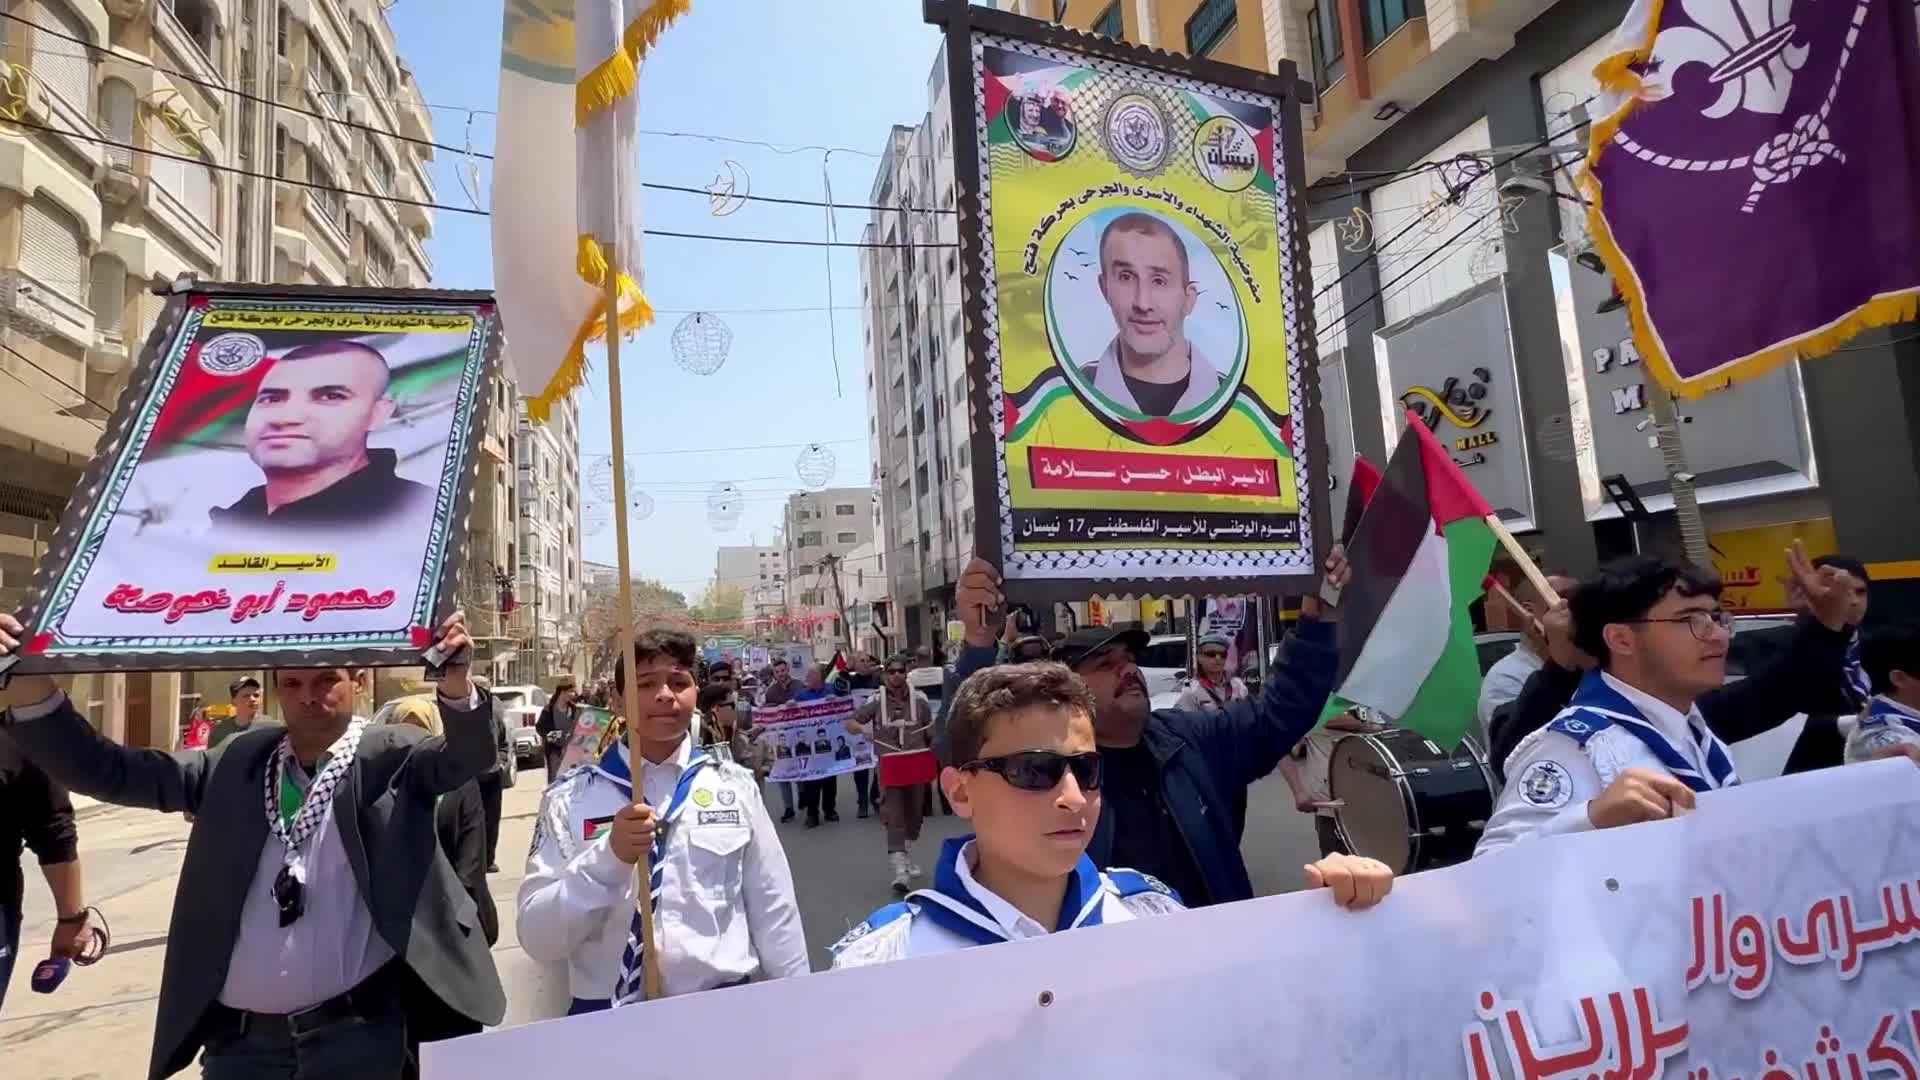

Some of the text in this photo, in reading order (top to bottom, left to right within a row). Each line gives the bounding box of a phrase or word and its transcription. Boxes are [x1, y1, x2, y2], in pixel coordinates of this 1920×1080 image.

[1206, 147, 1255, 170] نيسان
[1023, 182, 1261, 303] مفوضية الشهداء والأسرى والجرحى بحركة فتح
[1456, 432, 1497, 451] MALL
[1040, 457, 1115, 478] سلامة
[1120, 464, 1171, 484] حسن
[1022, 515, 1297, 540] اليوم الوطني للأسير الفلسطيني 17 نيسان
[269, 555, 331, 571] الأسير
[230, 580, 285, 624] أبو
[284, 588, 396, 621] محمود
